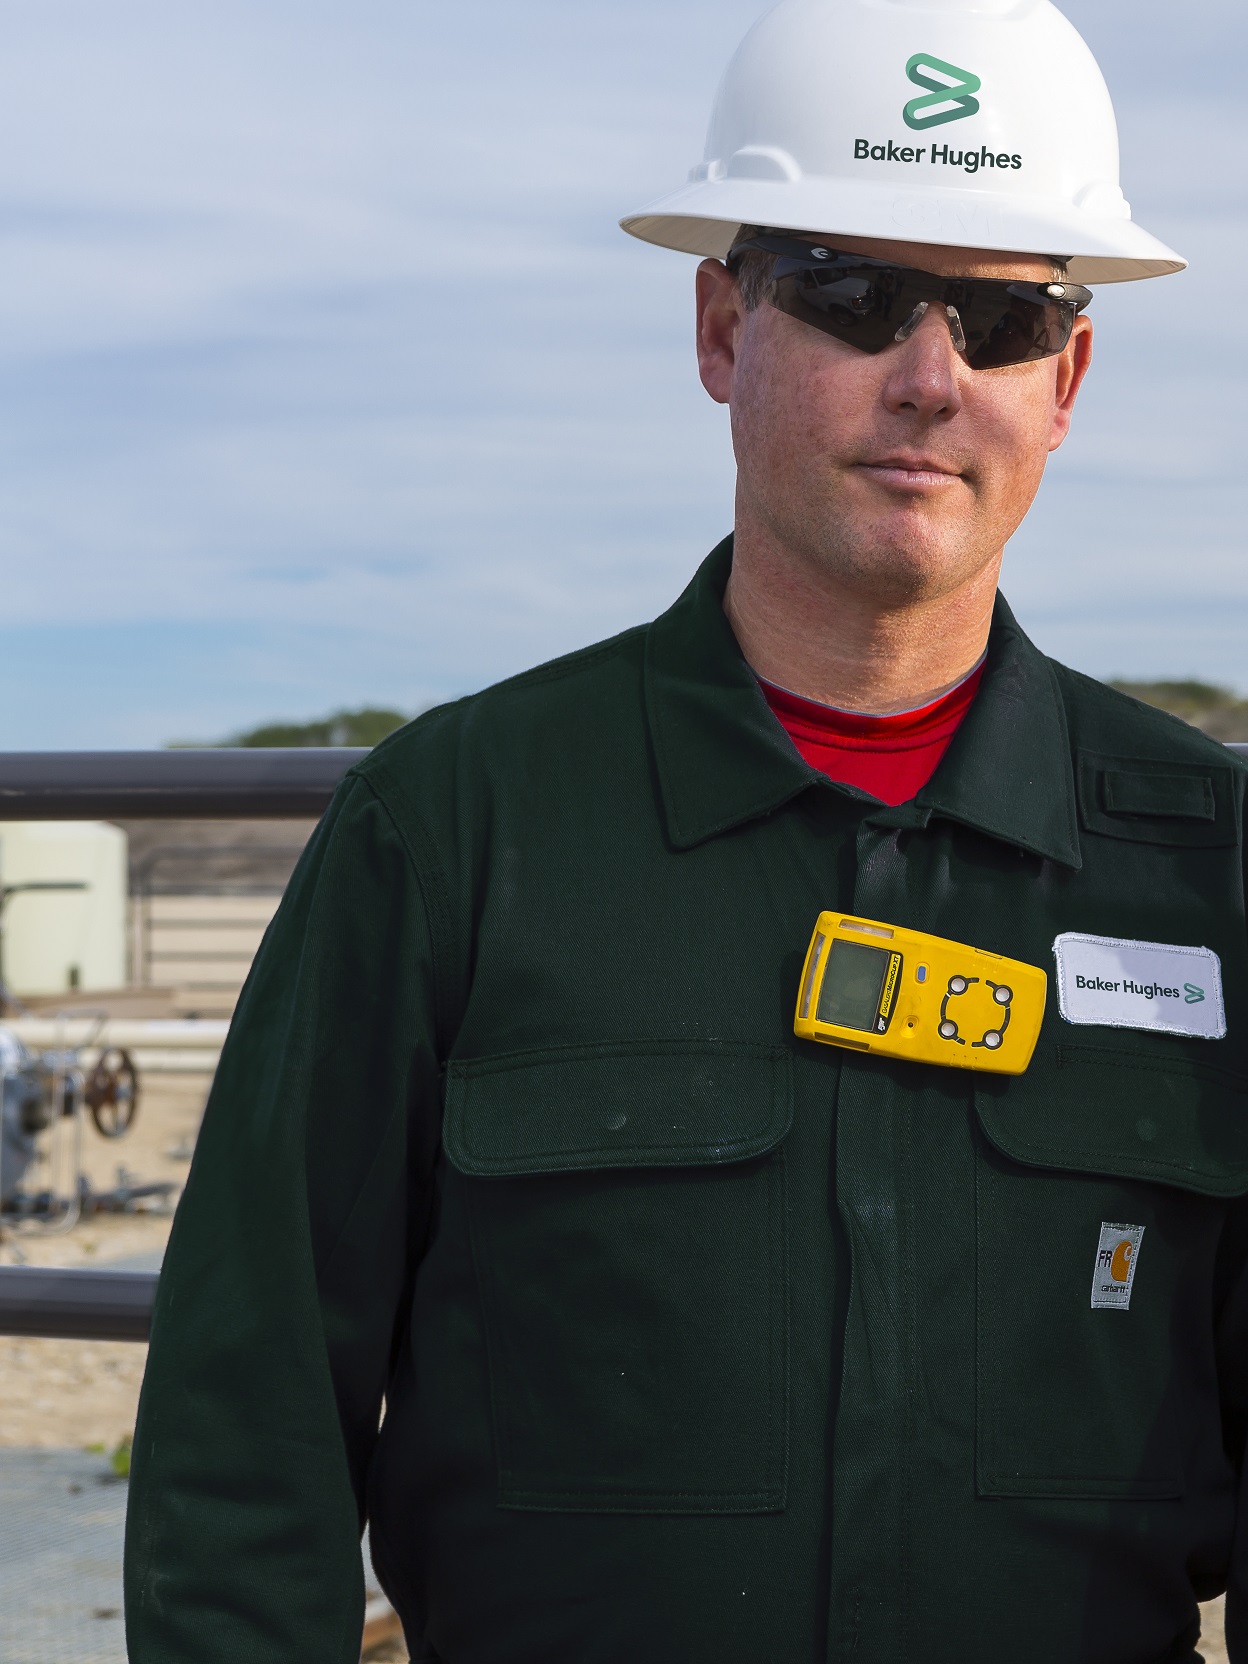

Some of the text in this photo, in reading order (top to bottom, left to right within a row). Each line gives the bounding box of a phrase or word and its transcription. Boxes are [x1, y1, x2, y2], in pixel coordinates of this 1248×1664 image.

[853, 138, 1022, 173] Baker Hughes
[1075, 975, 1180, 999] Baker Hughes
[1098, 1250, 1113, 1267] FR
